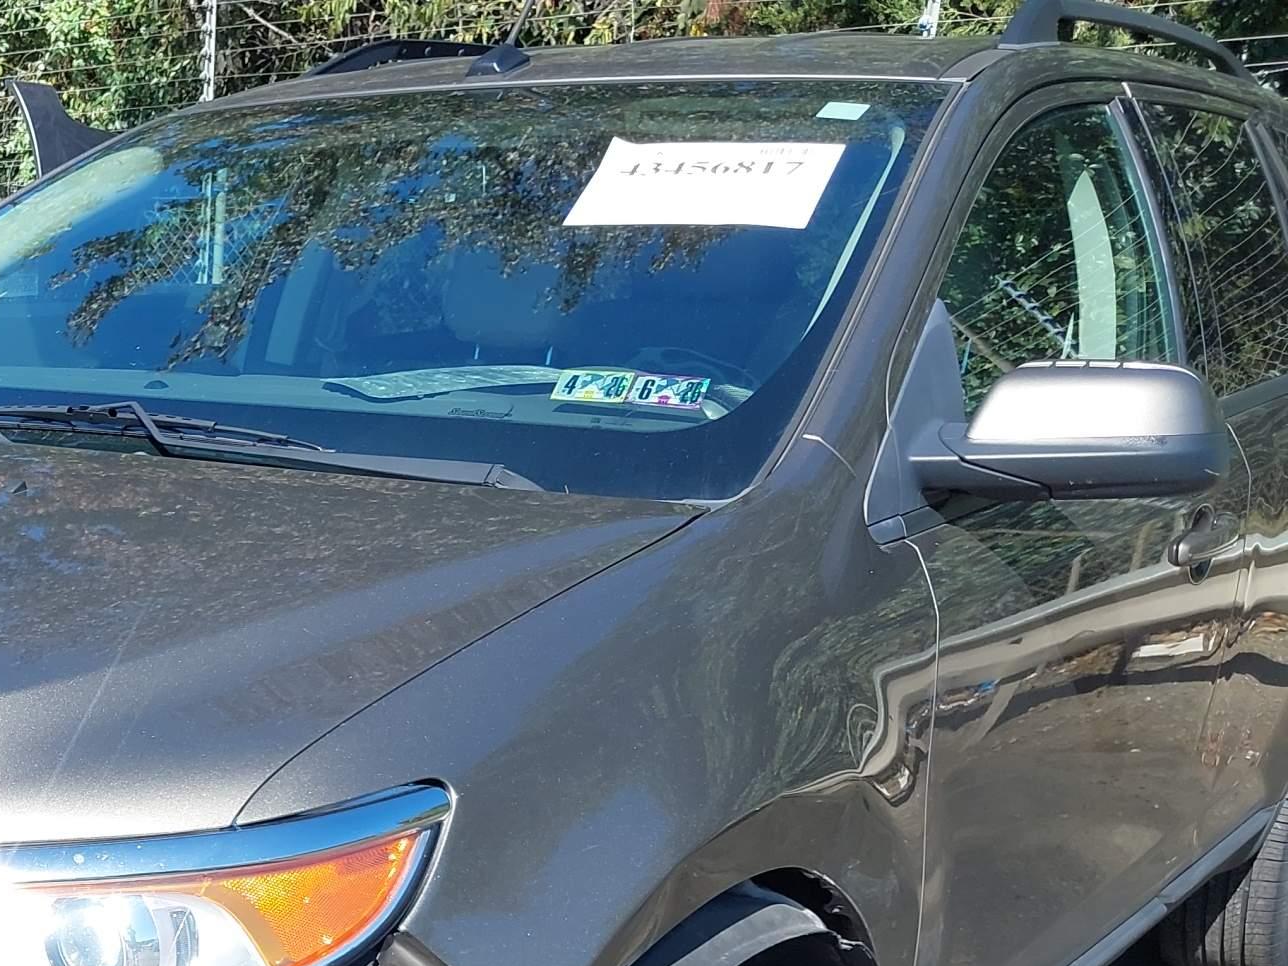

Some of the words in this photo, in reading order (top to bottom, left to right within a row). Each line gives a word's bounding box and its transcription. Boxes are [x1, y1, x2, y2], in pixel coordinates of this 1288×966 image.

[620, 160, 805, 176] 43456817
[564, 375, 580, 395] 4
[638, 379, 655, 400] 6
